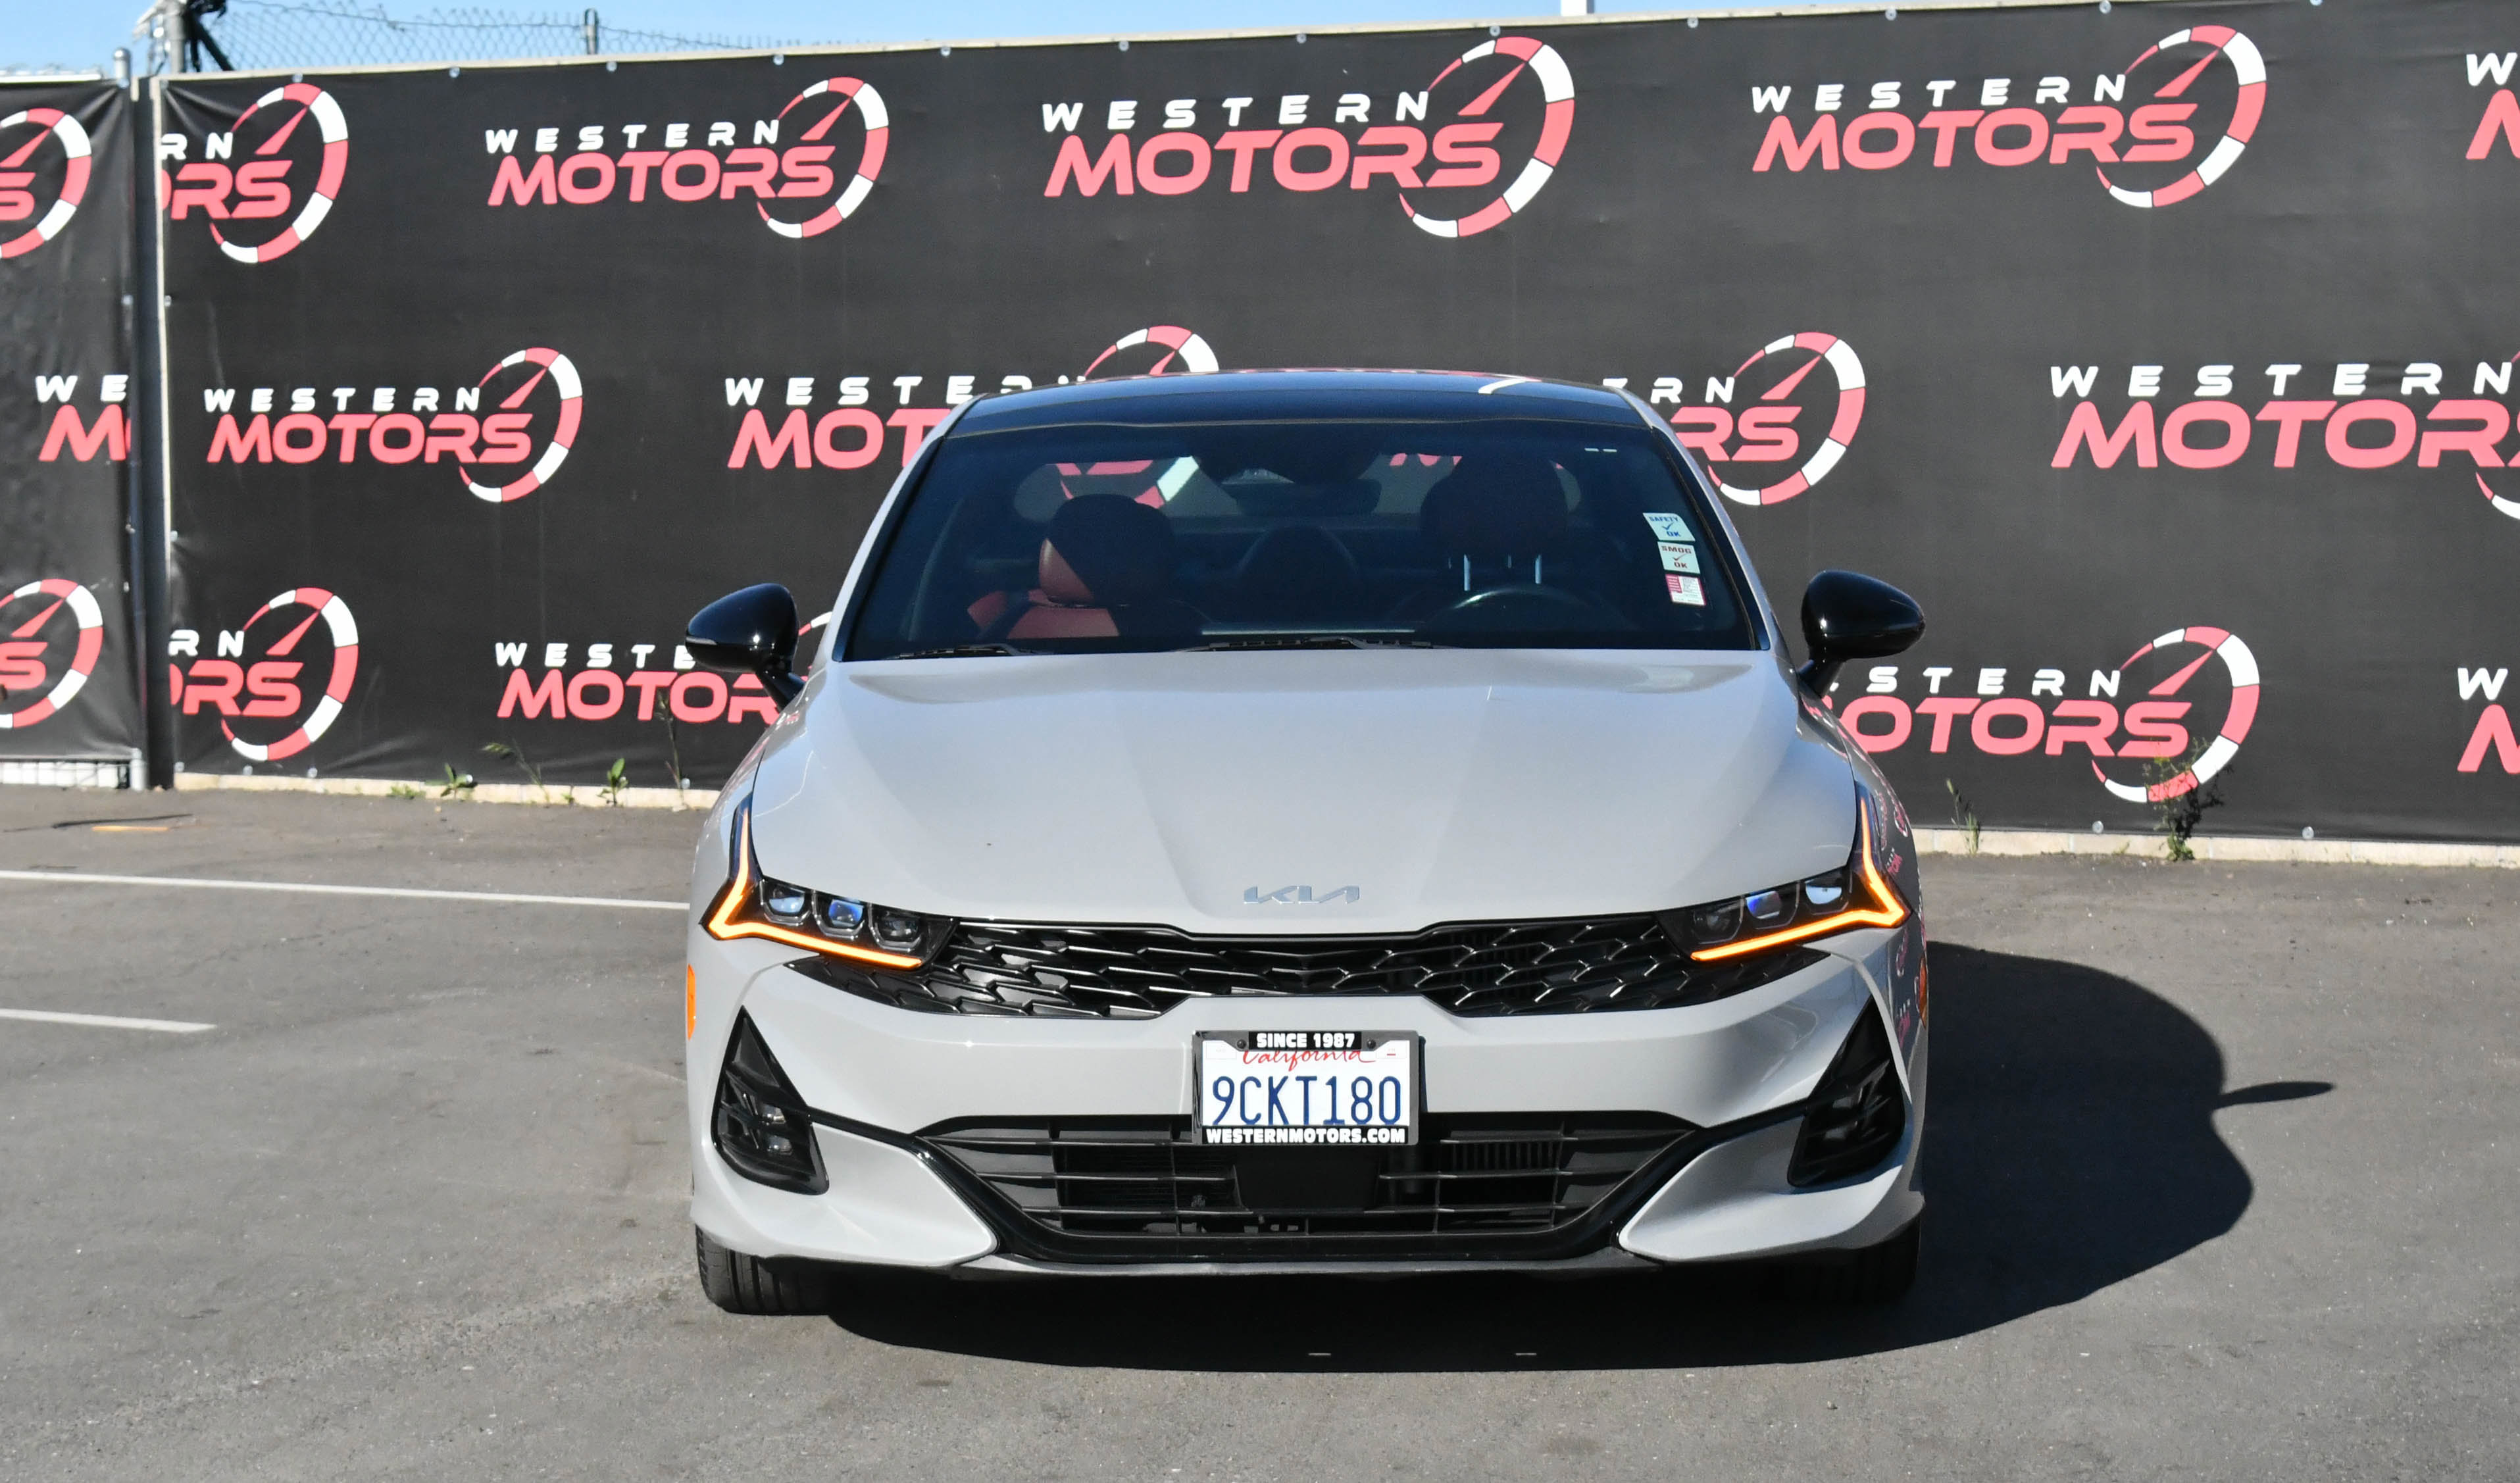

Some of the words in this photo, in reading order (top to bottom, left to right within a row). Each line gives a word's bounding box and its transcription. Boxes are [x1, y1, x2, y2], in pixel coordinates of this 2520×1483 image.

[1043, 91, 1428, 132] WESTERN
[1752, 74, 2125, 113] WESTERN
[486, 120, 779, 153] WESTERN
[1753, 103, 2198, 172] MOTORS
[488, 145, 836, 206] MOTORS
[1044, 122, 1503, 197] MOTORS
[725, 375, 1086, 406] WESTER
[2051, 362, 2512, 397] WESTERN
[205, 388, 480, 413] WESTERN
[207, 413, 533, 464] MOTORS
[727, 408, 951, 469] MOT
[2051, 399, 2520, 468] MOTOR
[1661, 545, 1692, 554] SMOG
[495, 643, 696, 669] WESTE
[496, 668, 780, 725] MOTOR
[1829, 666, 2121, 697] STERN
[1821, 695, 2192, 758] OTORS
[1244, 886, 1360, 904] KIA
[1257, 1033, 1307, 1048] SINCE
[1313, 1033, 1355, 1048] 1987
[1212, 1076, 1401, 1126] 9CKT180
[1206, 1128, 1405, 1144] WESTERNMOTORS.COM
